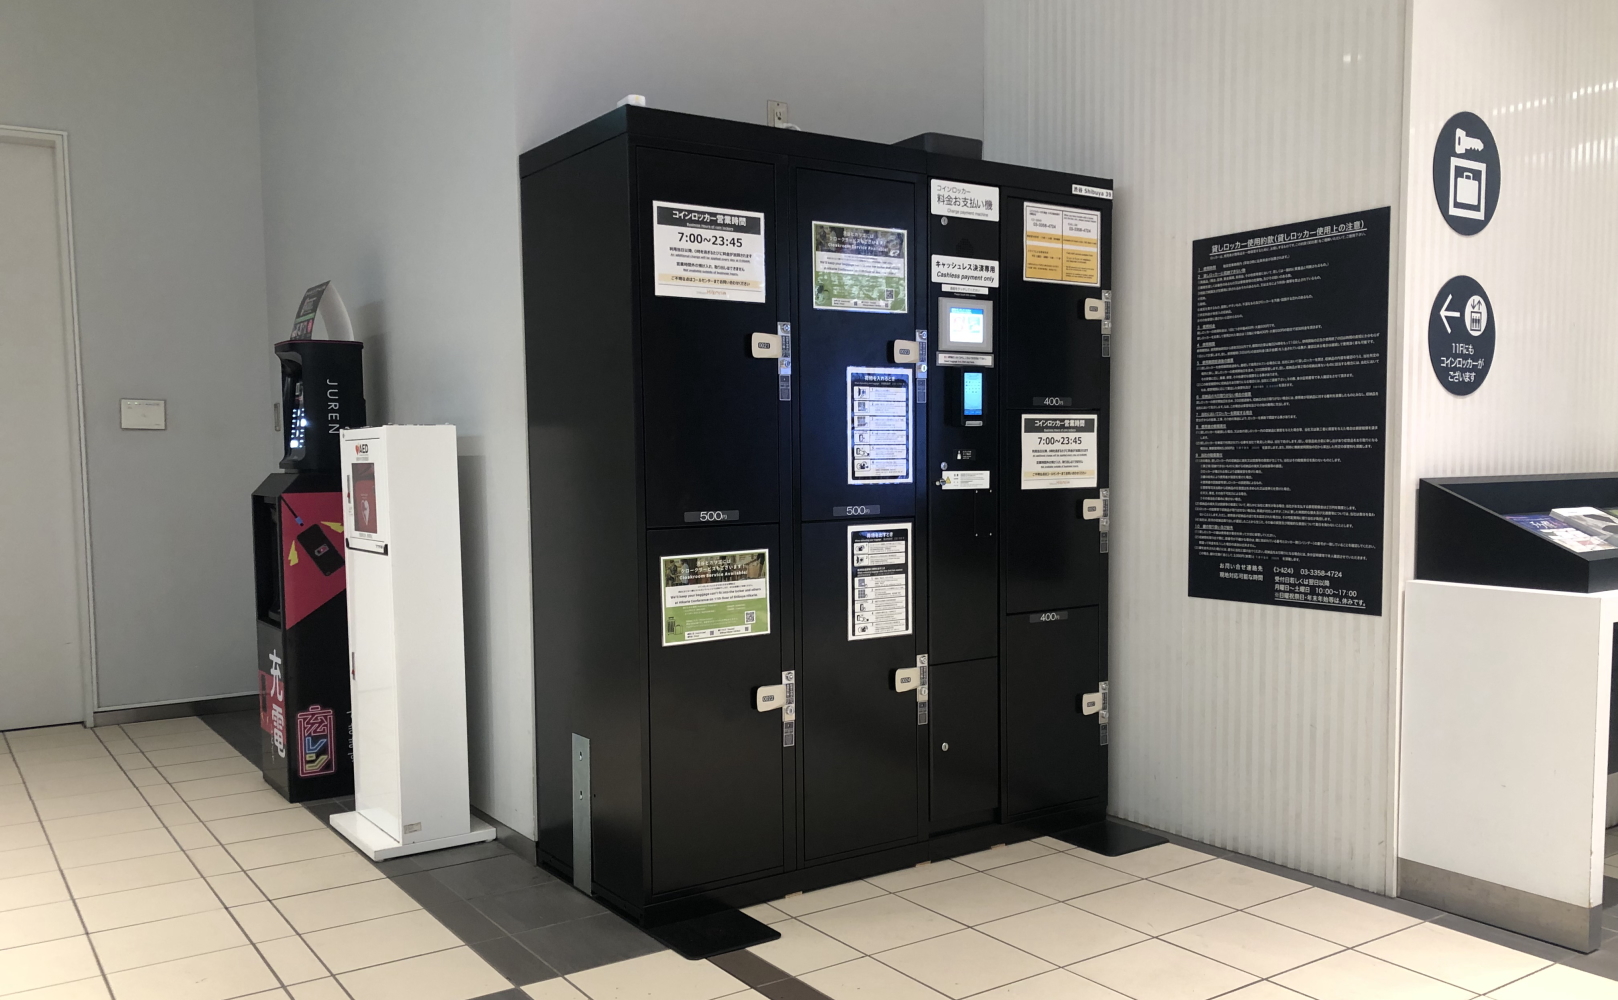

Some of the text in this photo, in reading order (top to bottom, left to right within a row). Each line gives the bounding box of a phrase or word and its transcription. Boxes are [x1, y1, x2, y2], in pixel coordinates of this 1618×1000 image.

[937, 185, 971, 194] コインロッカー
[1085, 188, 1104, 196] Shibuya
[936, 194, 993, 210] 料金お支払い機
[673, 211, 746, 226] コインロッカー営業時間
[936, 260, 995, 273] キャッシュレス決済専用
[937, 271, 994, 283] Cashless payment only
[1452, 343, 1474, 354] 11Fにも
[1441, 358, 1484, 369] コインロッカーが
[1449, 371, 1476, 382] ございます
[360, 444, 368, 453] AED
[1300, 569, 1342, 577] 03-3358-4724
[269, 649, 285, 758] 充電
